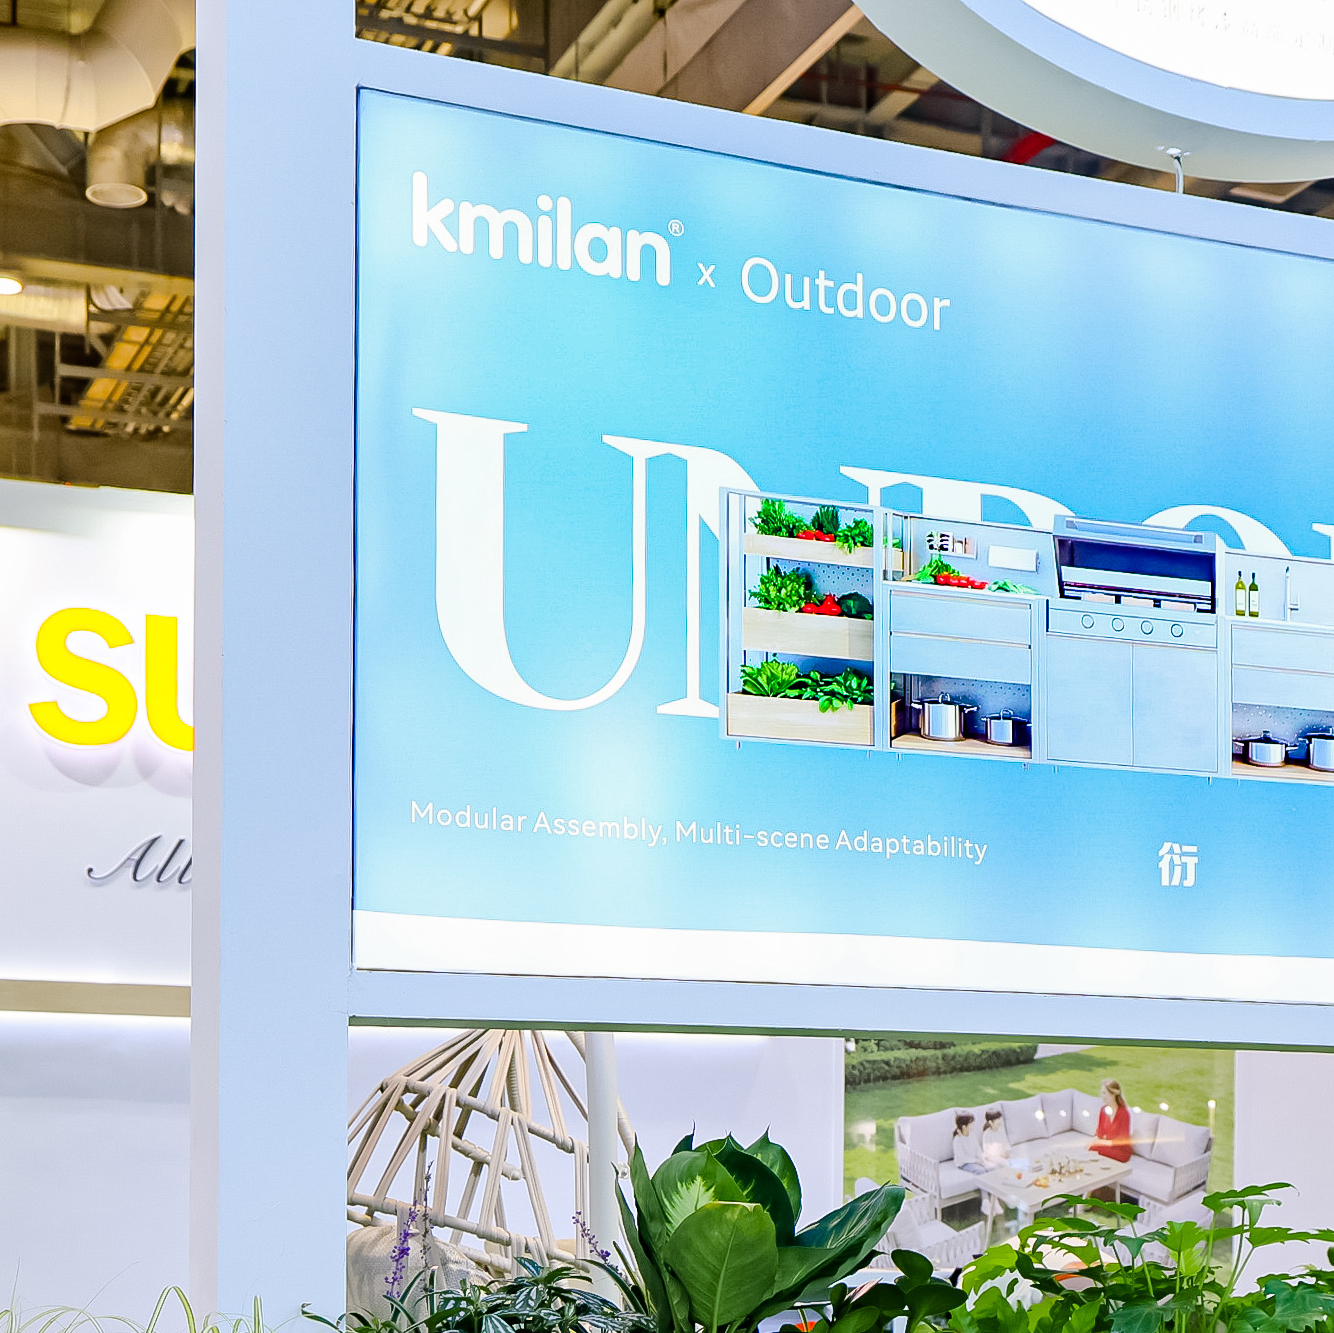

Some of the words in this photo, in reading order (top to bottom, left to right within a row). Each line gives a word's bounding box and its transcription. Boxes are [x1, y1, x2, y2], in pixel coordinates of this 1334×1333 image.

[741, 256, 951, 330] Outdoor
[410, 800, 527, 833] Modular
[532, 809, 668, 847] Assembly,
[675, 819, 830, 851] Multi-scene
[835, 829, 988, 865] Adaptability
